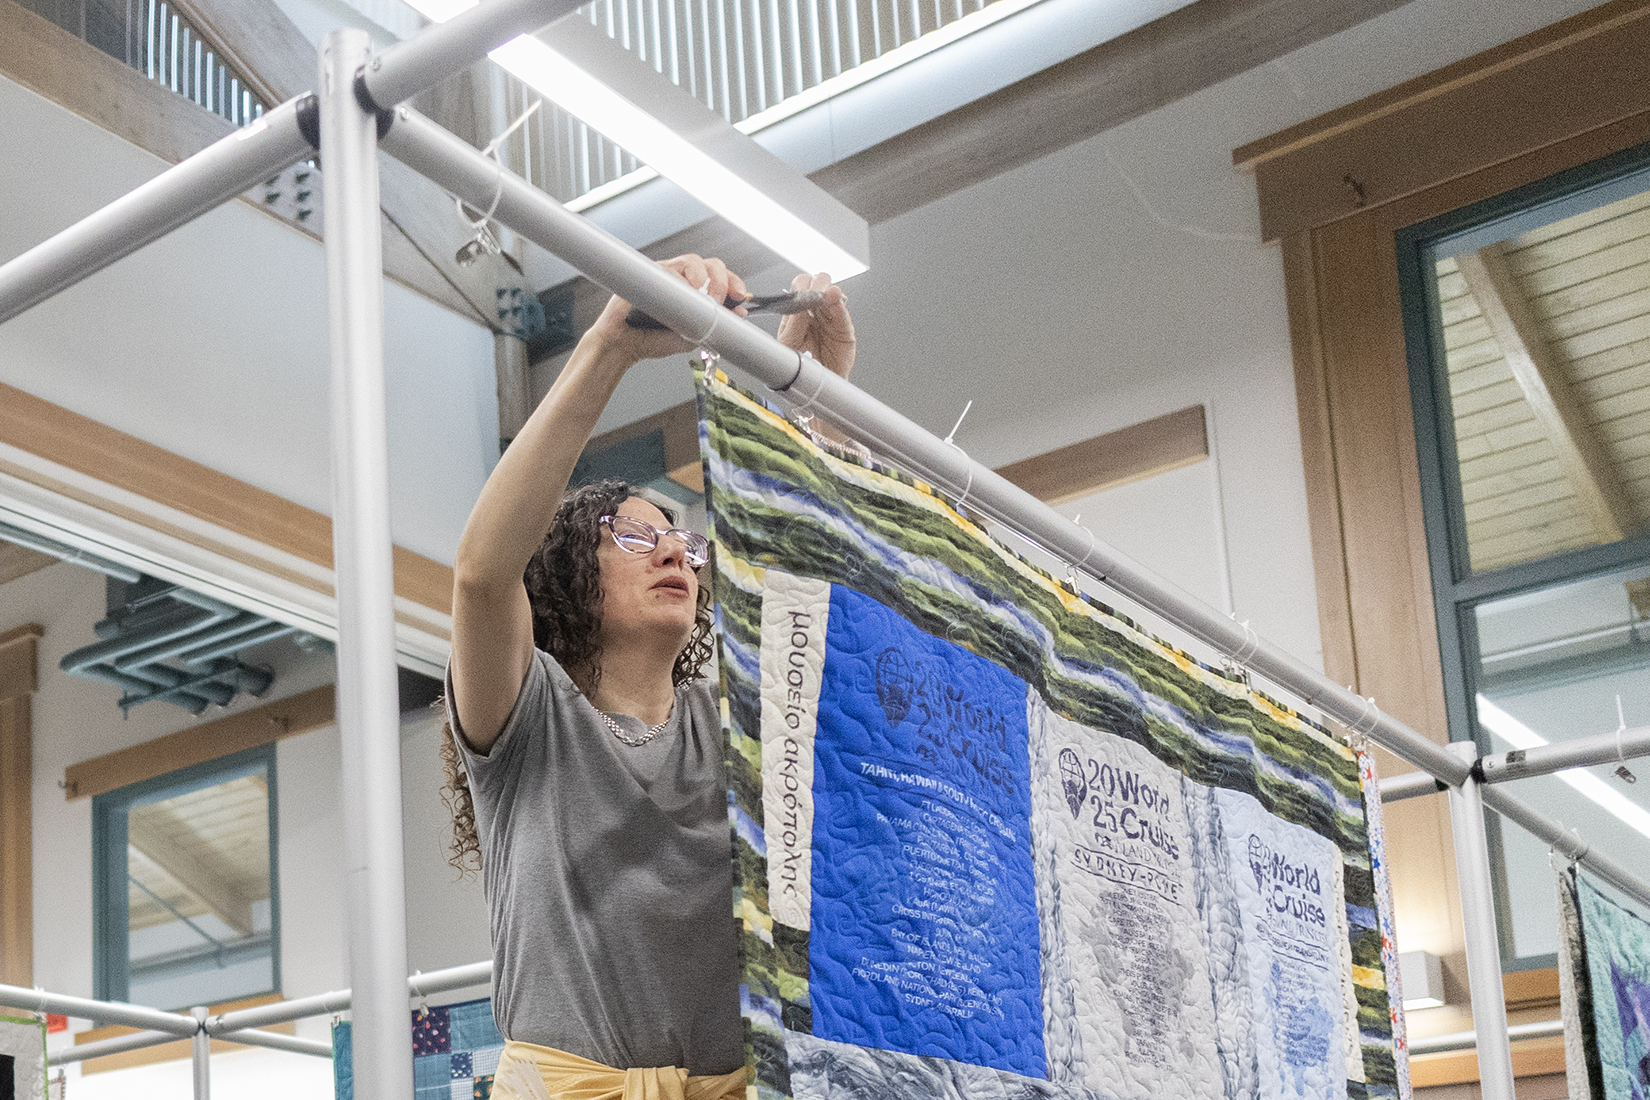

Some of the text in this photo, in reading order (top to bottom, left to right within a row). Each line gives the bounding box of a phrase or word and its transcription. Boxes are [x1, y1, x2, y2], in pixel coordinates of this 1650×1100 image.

[1088, 758, 1115, 798] 20
[1091, 795, 1118, 833] 25
[1272, 852, 1321, 896] World
[1273, 884, 1326, 928] Cruise
